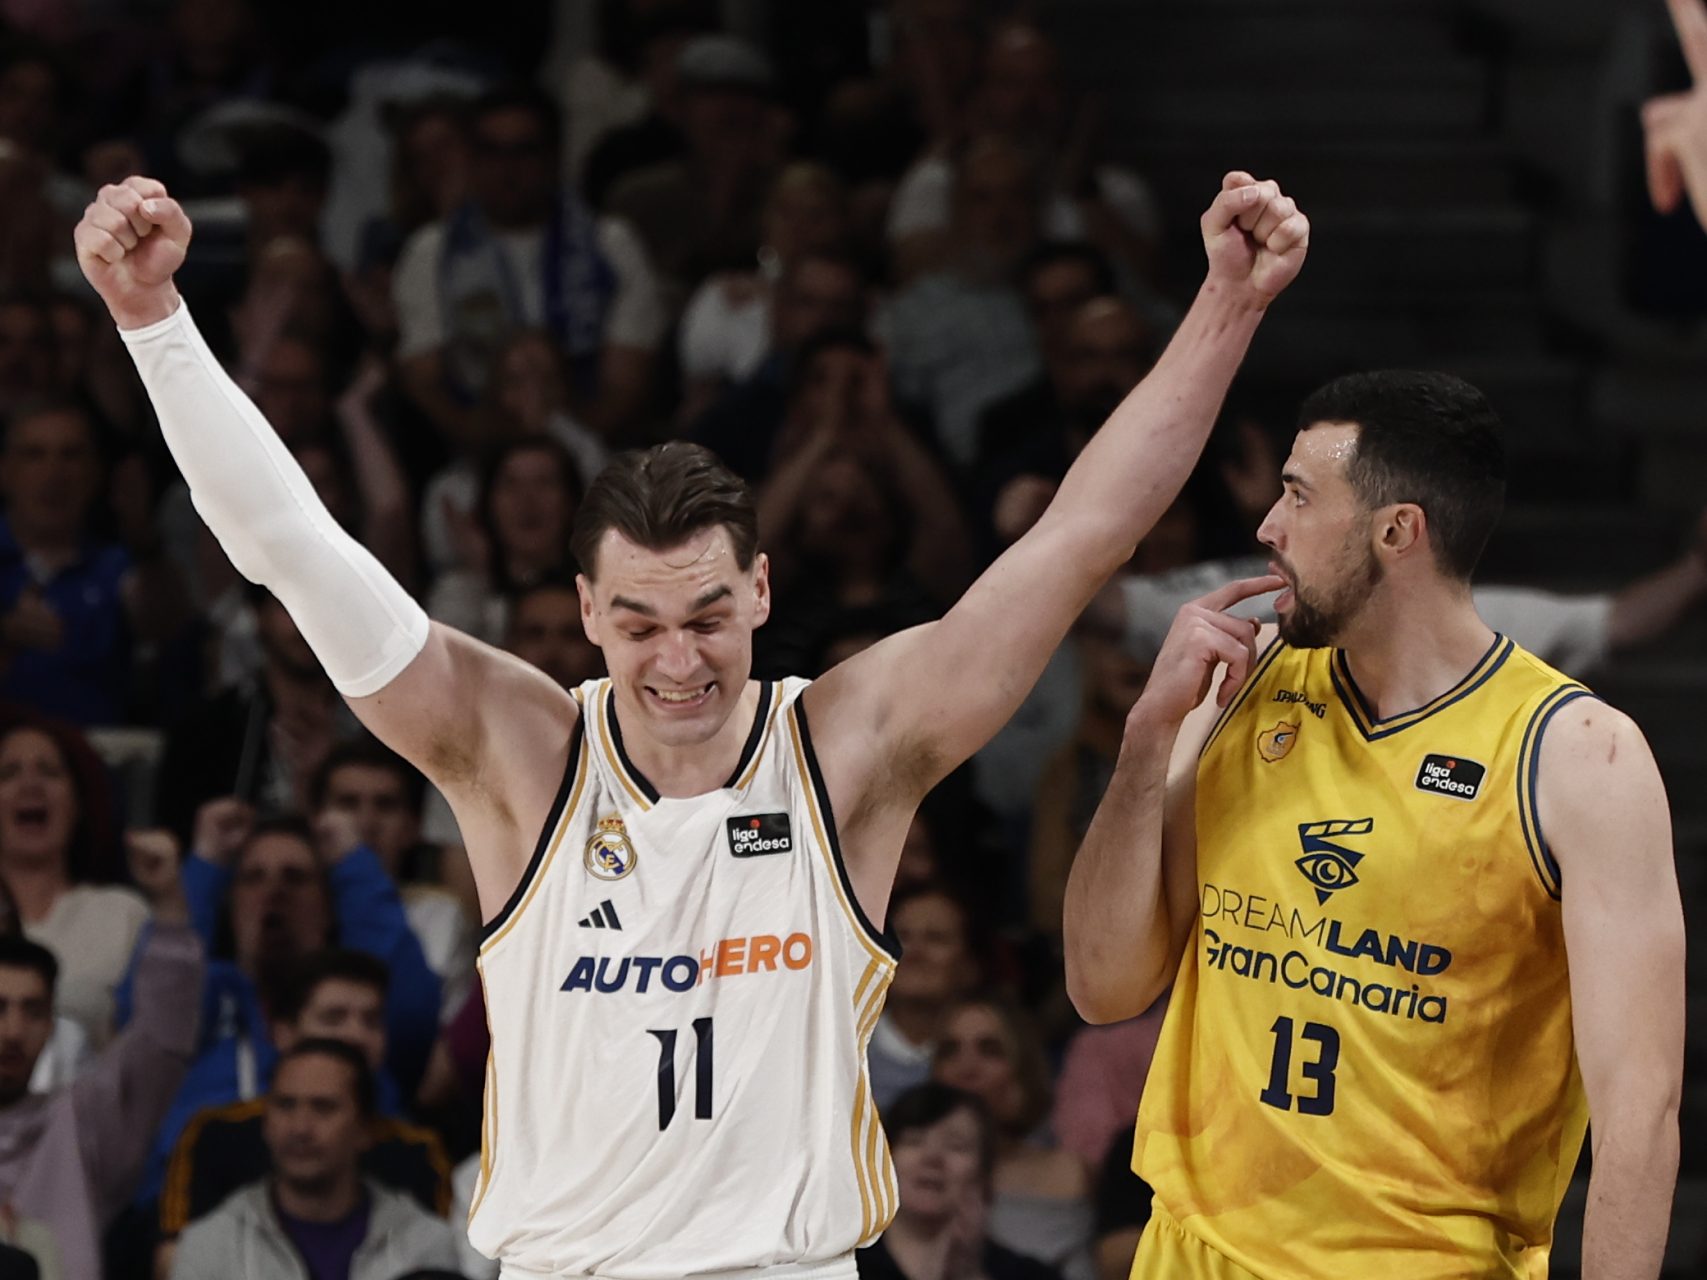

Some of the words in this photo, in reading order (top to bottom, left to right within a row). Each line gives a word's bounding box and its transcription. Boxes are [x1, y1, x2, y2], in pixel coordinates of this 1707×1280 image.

[1421, 776, 1475, 795] endesa
[1424, 762, 1451, 777] liga
[732, 828, 758, 842] liga
[734, 838, 789, 853] endesa
[1201, 883, 1452, 976] DREAMLAND
[559, 932, 812, 993] AUTOHERO
[645, 1016, 713, 1131] 11
[1259, 1015, 1340, 1117] 13
